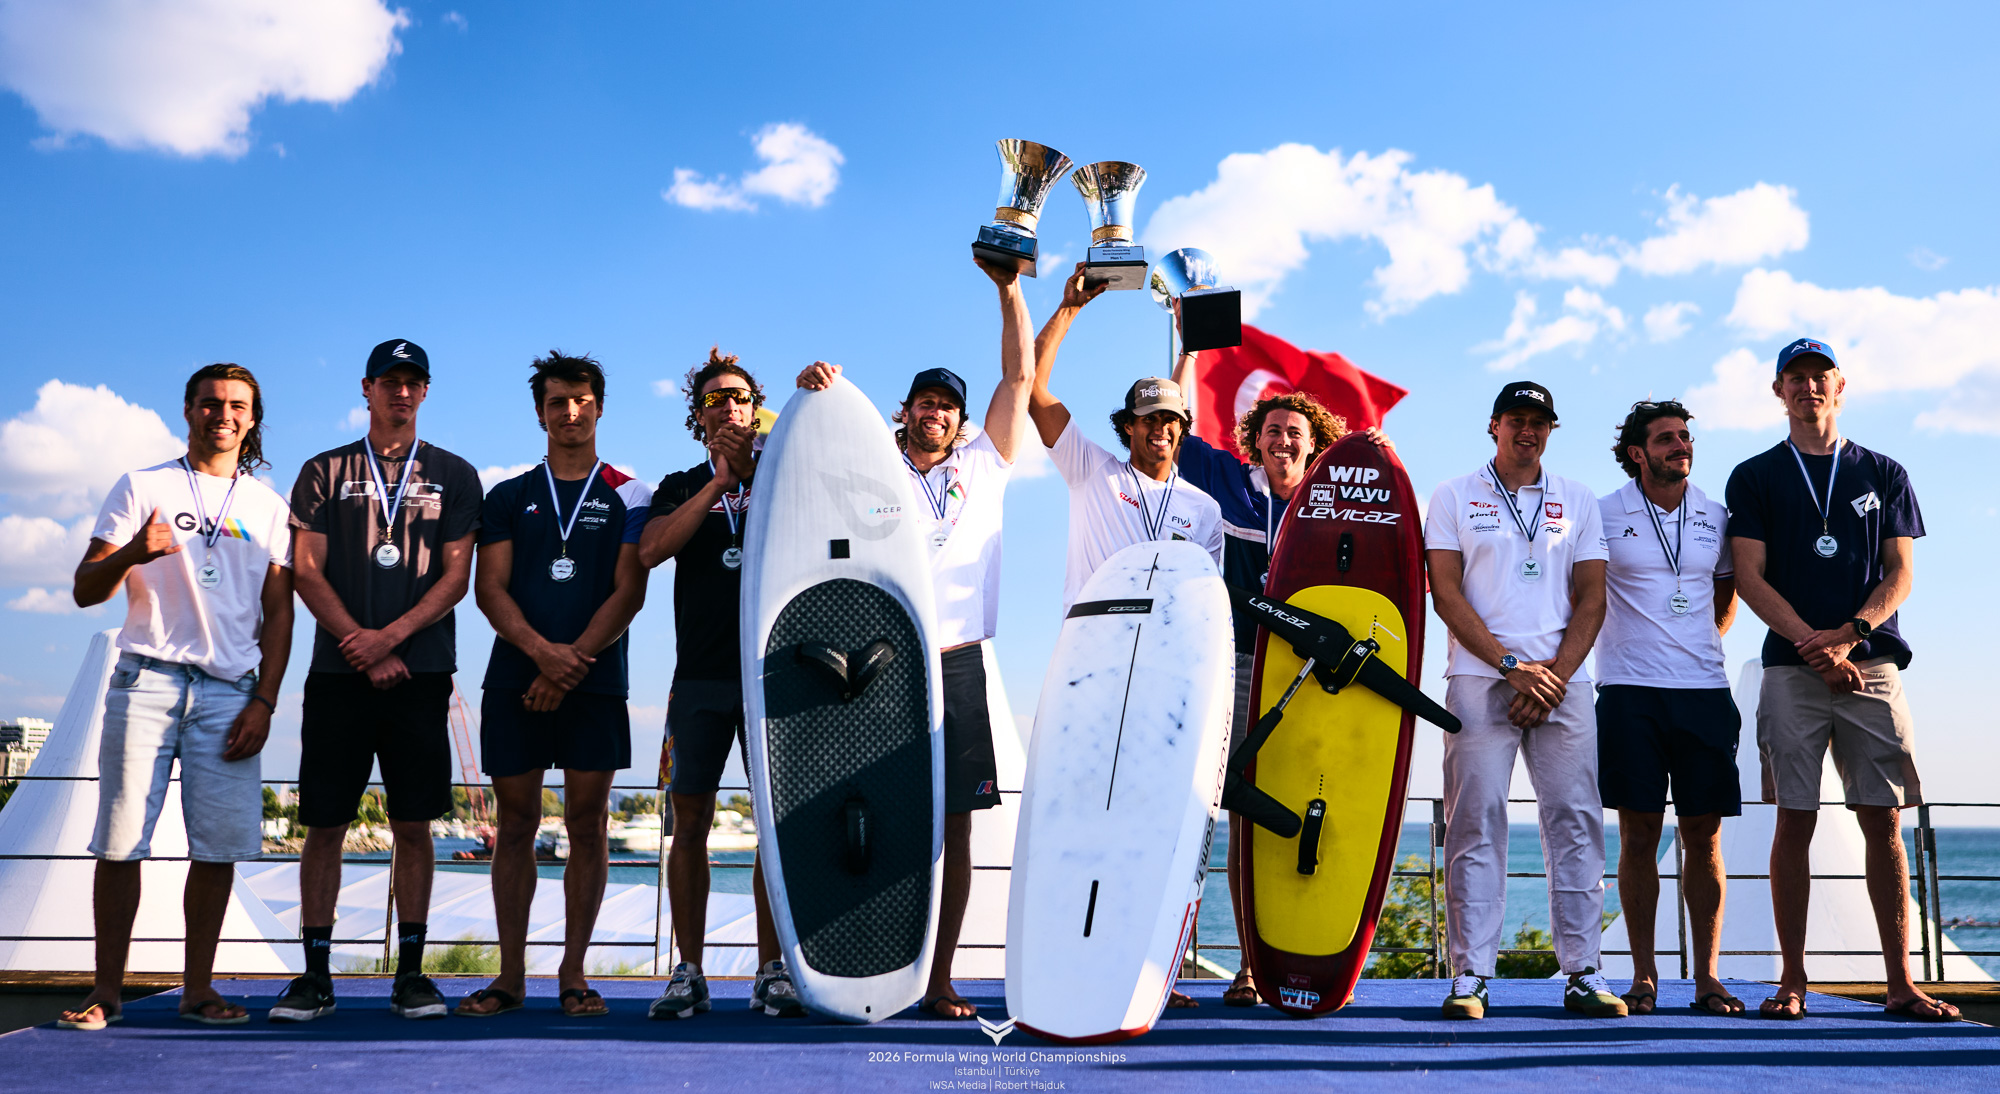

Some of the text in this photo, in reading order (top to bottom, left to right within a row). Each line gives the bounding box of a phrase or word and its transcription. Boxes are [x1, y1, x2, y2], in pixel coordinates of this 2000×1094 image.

[1328, 465, 1380, 485] WIP
[1311, 489, 1333, 502] FOIL
[1339, 485, 1391, 503] VAYU
[1171, 515, 1187, 526] FIV
[1545, 526, 1563, 534] PGE
[1279, 986, 1320, 1007] WIP
